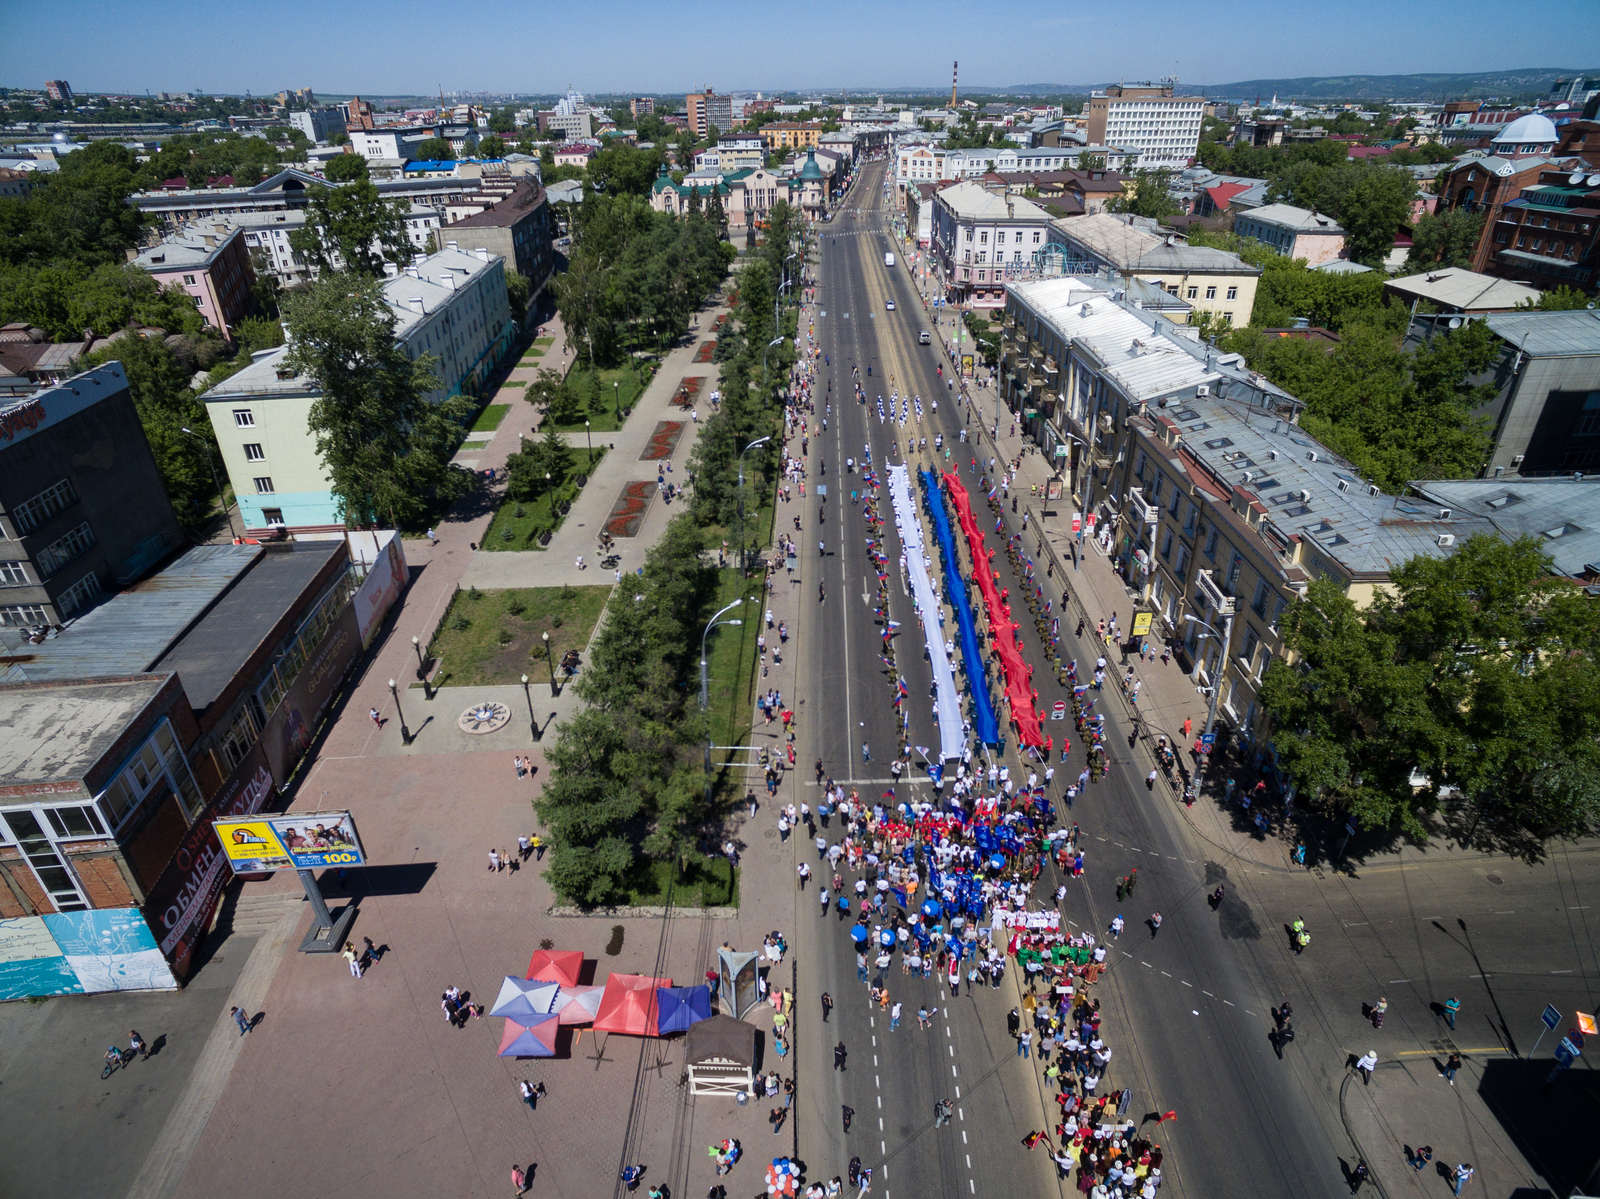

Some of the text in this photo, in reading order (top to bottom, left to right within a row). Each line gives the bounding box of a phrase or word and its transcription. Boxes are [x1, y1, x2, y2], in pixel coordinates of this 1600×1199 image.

[308, 631, 348, 693] GUALTIERO
[164, 844, 214, 929] ОБМЕН
[167, 900, 201, 947] МЕНЯЕМ
[198, 857, 221, 899] СТАРОЕ
